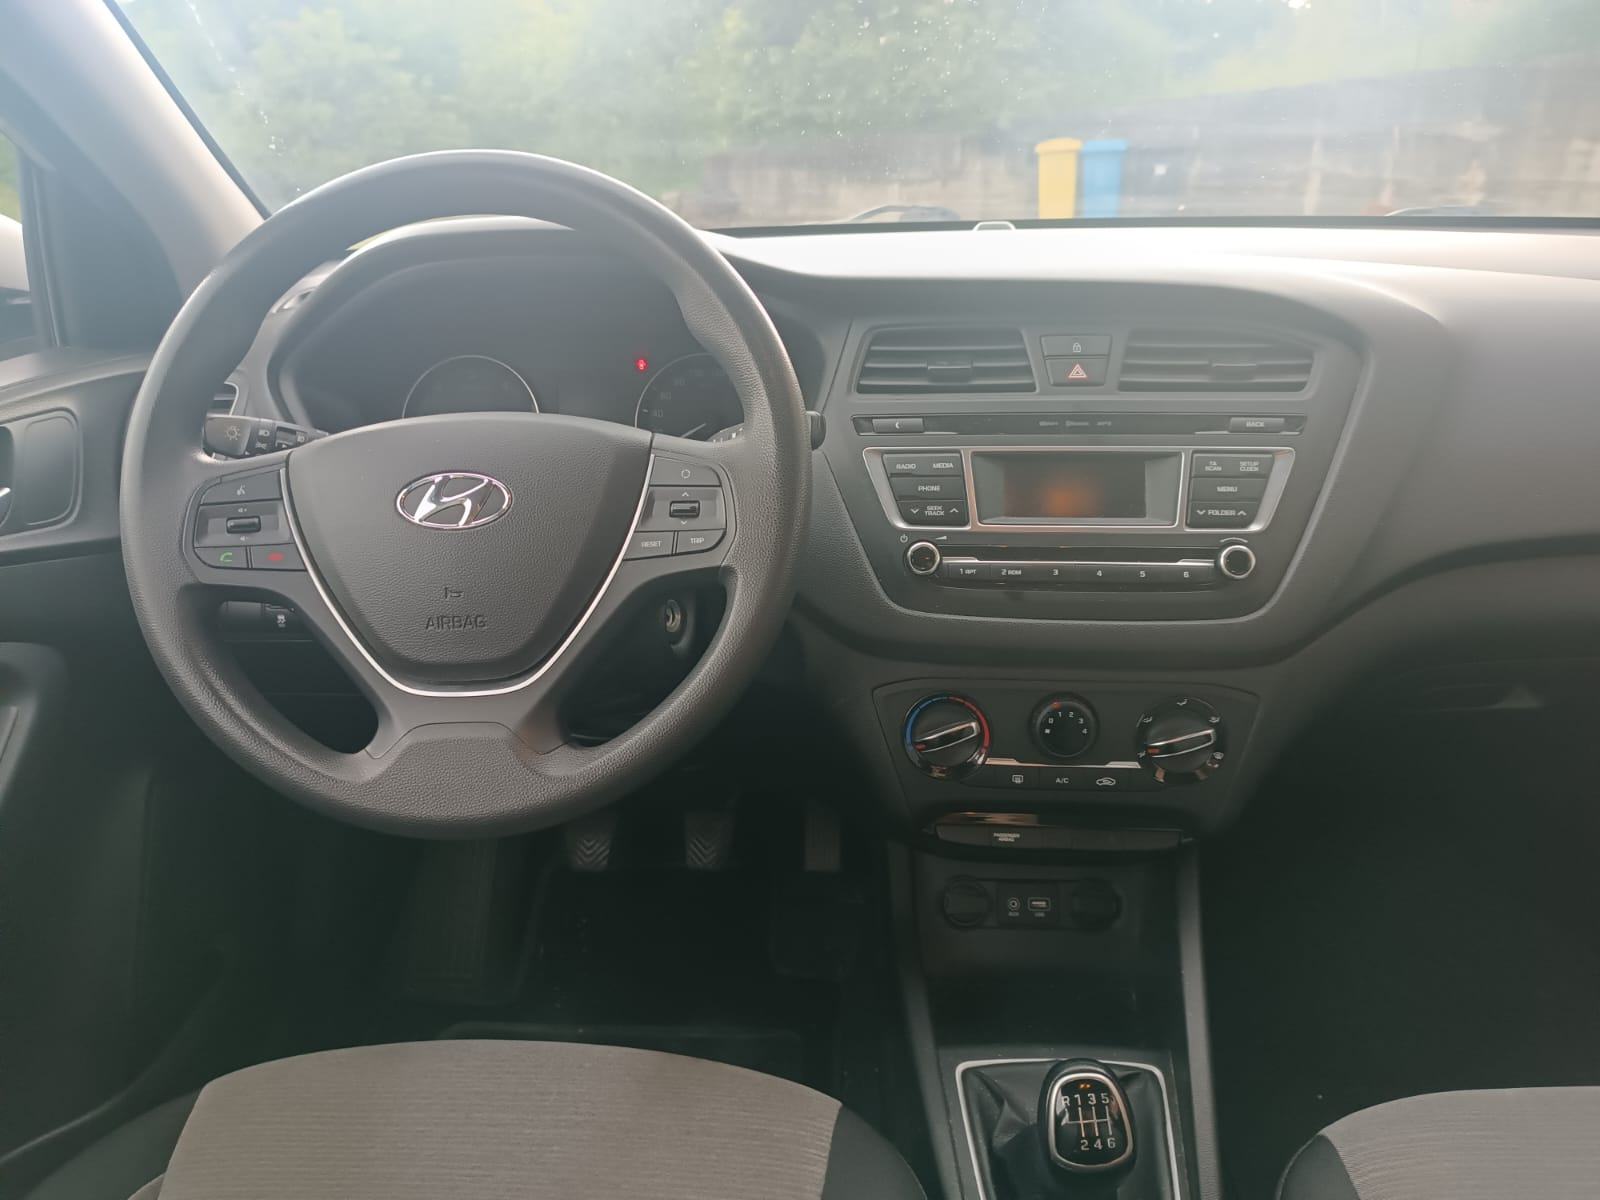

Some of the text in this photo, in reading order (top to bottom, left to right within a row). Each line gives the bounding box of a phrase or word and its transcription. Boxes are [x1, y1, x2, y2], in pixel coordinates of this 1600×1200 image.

[641, 540, 662, 548] RESET
[690, 537, 705, 545] TRIP
[1001, 568, 1007, 576] 2
[1053, 568, 1059, 576] 3
[1096, 569, 1102, 577] 4
[1139, 570, 1146, 578] 5
[425, 615, 487, 630] AIRBAG
[1074, 1094, 1081, 1106] 1
[1087, 1093, 1097, 1105] 3
[1100, 1093, 1109, 1104] 5
[1080, 1137, 1116, 1151] 2 4 6
